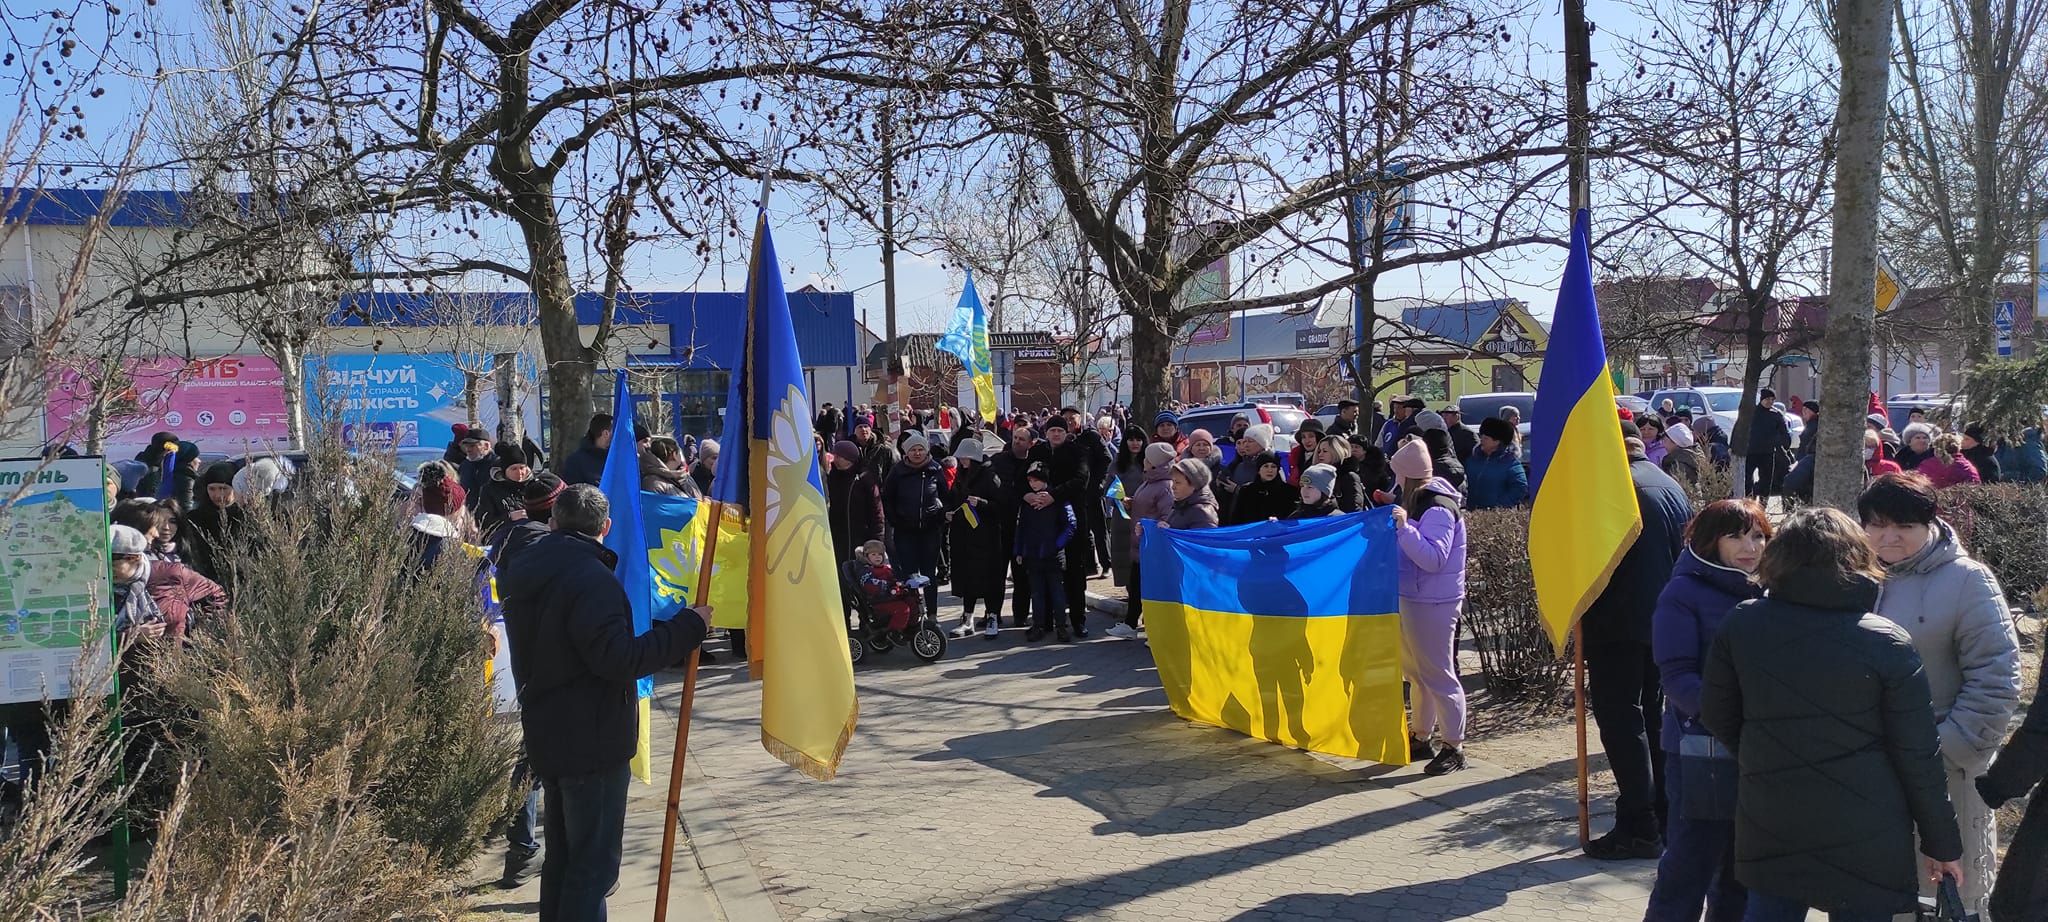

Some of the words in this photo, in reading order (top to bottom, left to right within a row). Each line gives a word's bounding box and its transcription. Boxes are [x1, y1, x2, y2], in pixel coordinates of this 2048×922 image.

[1308, 334, 1328, 344] GRADUS
[1486, 341, 1533, 353] ФЕРМА
[1018, 349, 1056, 358] КРУЖКА
[326, 365, 416, 387] ВІДЧУЙ
[368, 387, 411, 395] СПРАВАХ
